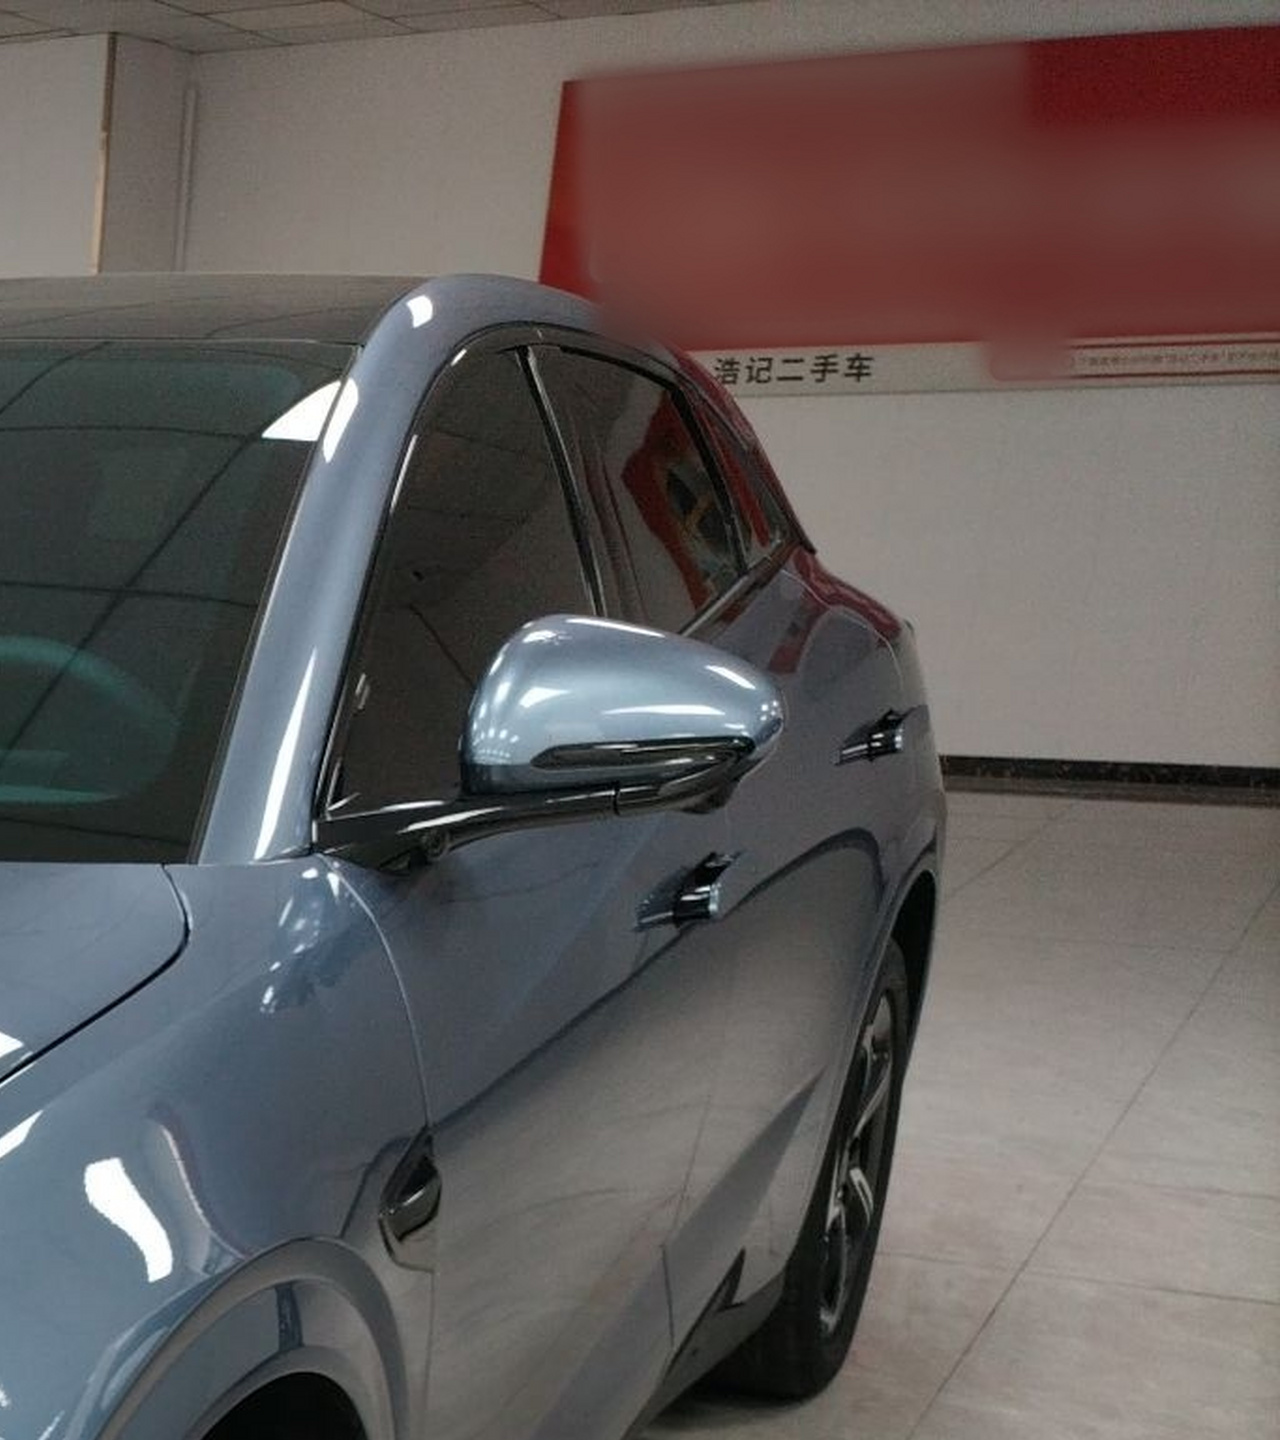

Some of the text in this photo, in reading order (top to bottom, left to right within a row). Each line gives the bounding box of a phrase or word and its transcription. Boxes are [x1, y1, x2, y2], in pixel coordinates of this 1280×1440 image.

[714, 353, 874, 385] 浩记二手车
